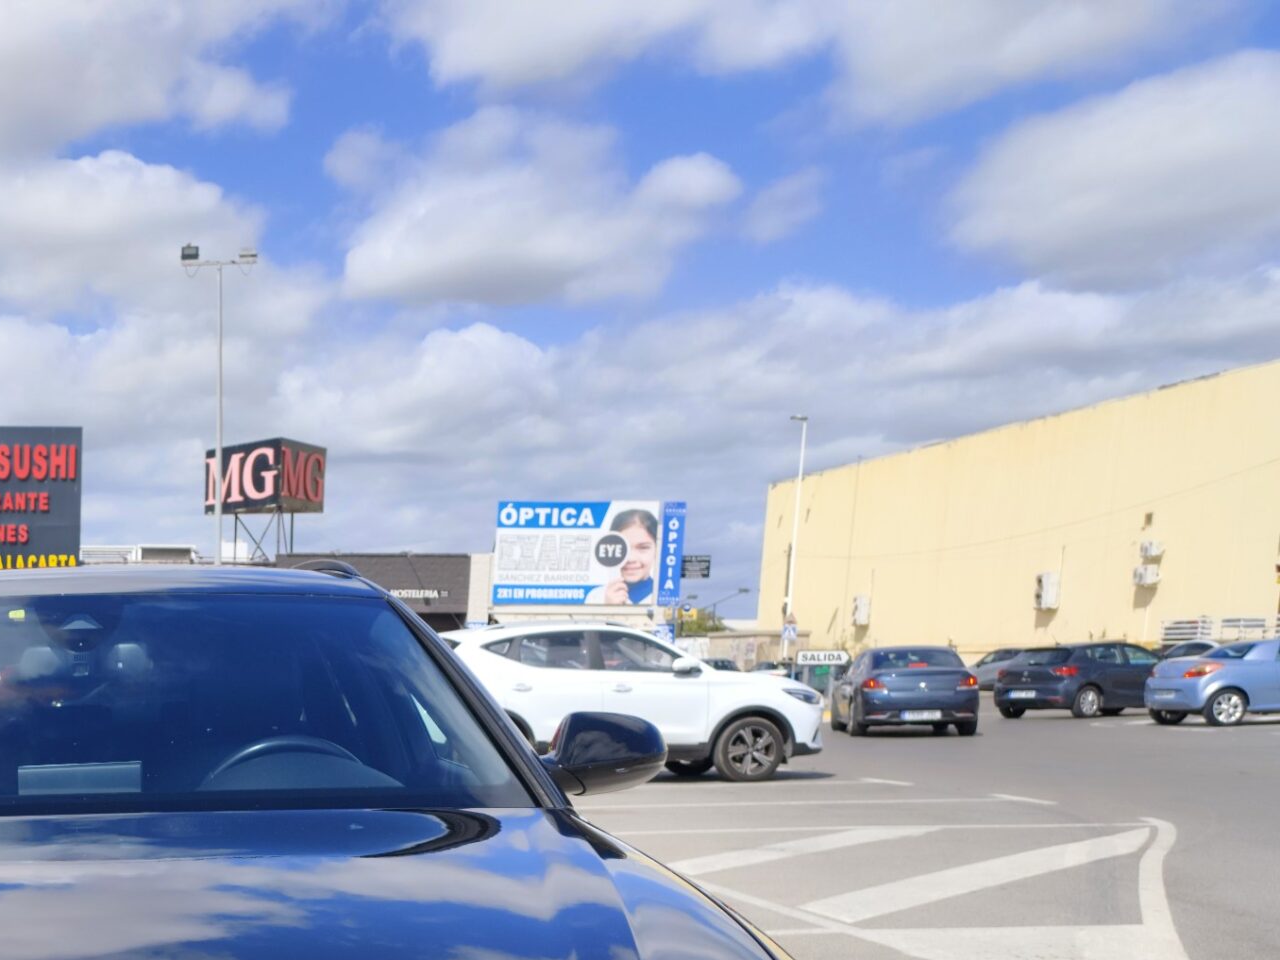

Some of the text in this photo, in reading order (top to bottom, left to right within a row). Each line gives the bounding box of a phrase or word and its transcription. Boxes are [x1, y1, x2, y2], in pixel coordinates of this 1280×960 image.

[205, 447, 278, 505] MG
[281, 446, 325, 502] MG
[500, 503, 595, 526] ÓPTICA
[598, 544, 622, 557] EYE
[513, 588, 524, 599] EN
[525, 588, 585, 600] PROGRESIVOS
[801, 653, 842, 662] SALIDA
